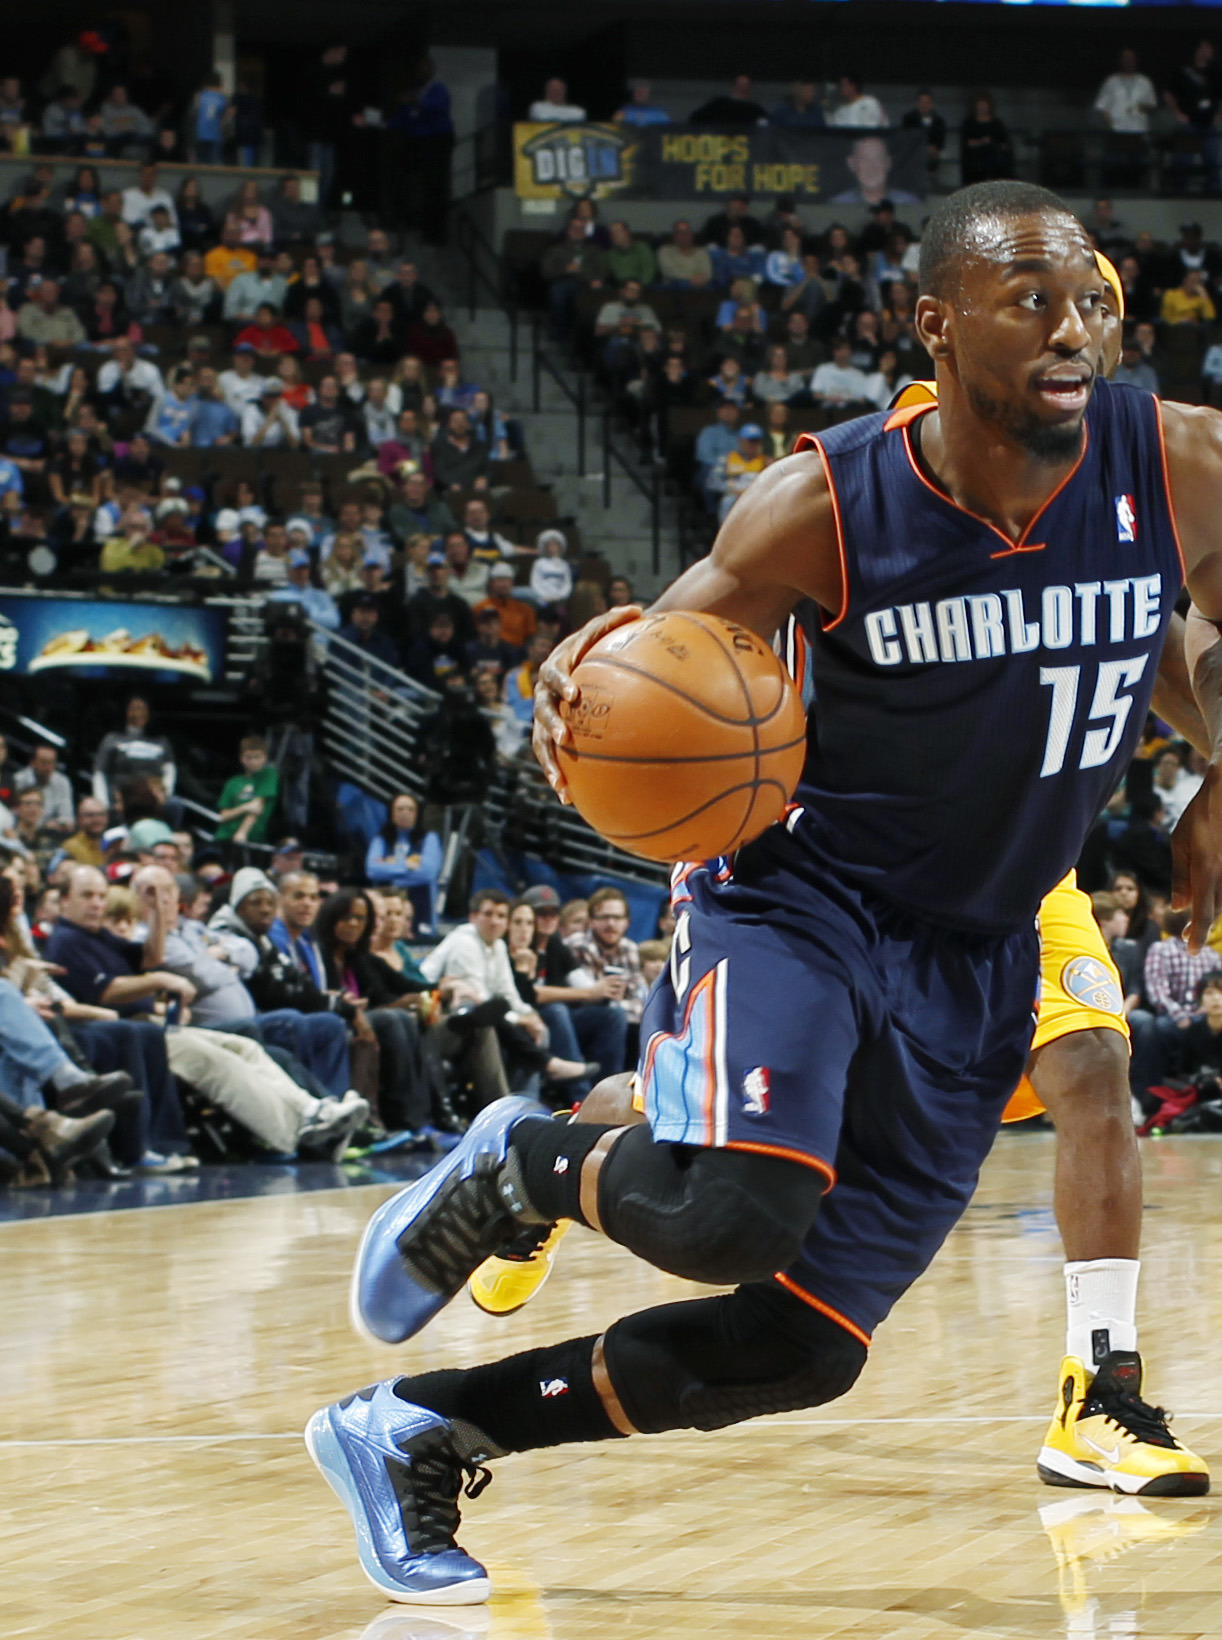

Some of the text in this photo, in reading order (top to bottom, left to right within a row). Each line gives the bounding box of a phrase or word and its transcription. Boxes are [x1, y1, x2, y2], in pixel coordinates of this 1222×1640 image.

[661, 133, 750, 162] HOOPS
[694, 163, 820, 192] FOR HOPE
[864, 573, 1161, 666] CHARLOTTE
[1039, 653, 1150, 778] 15
